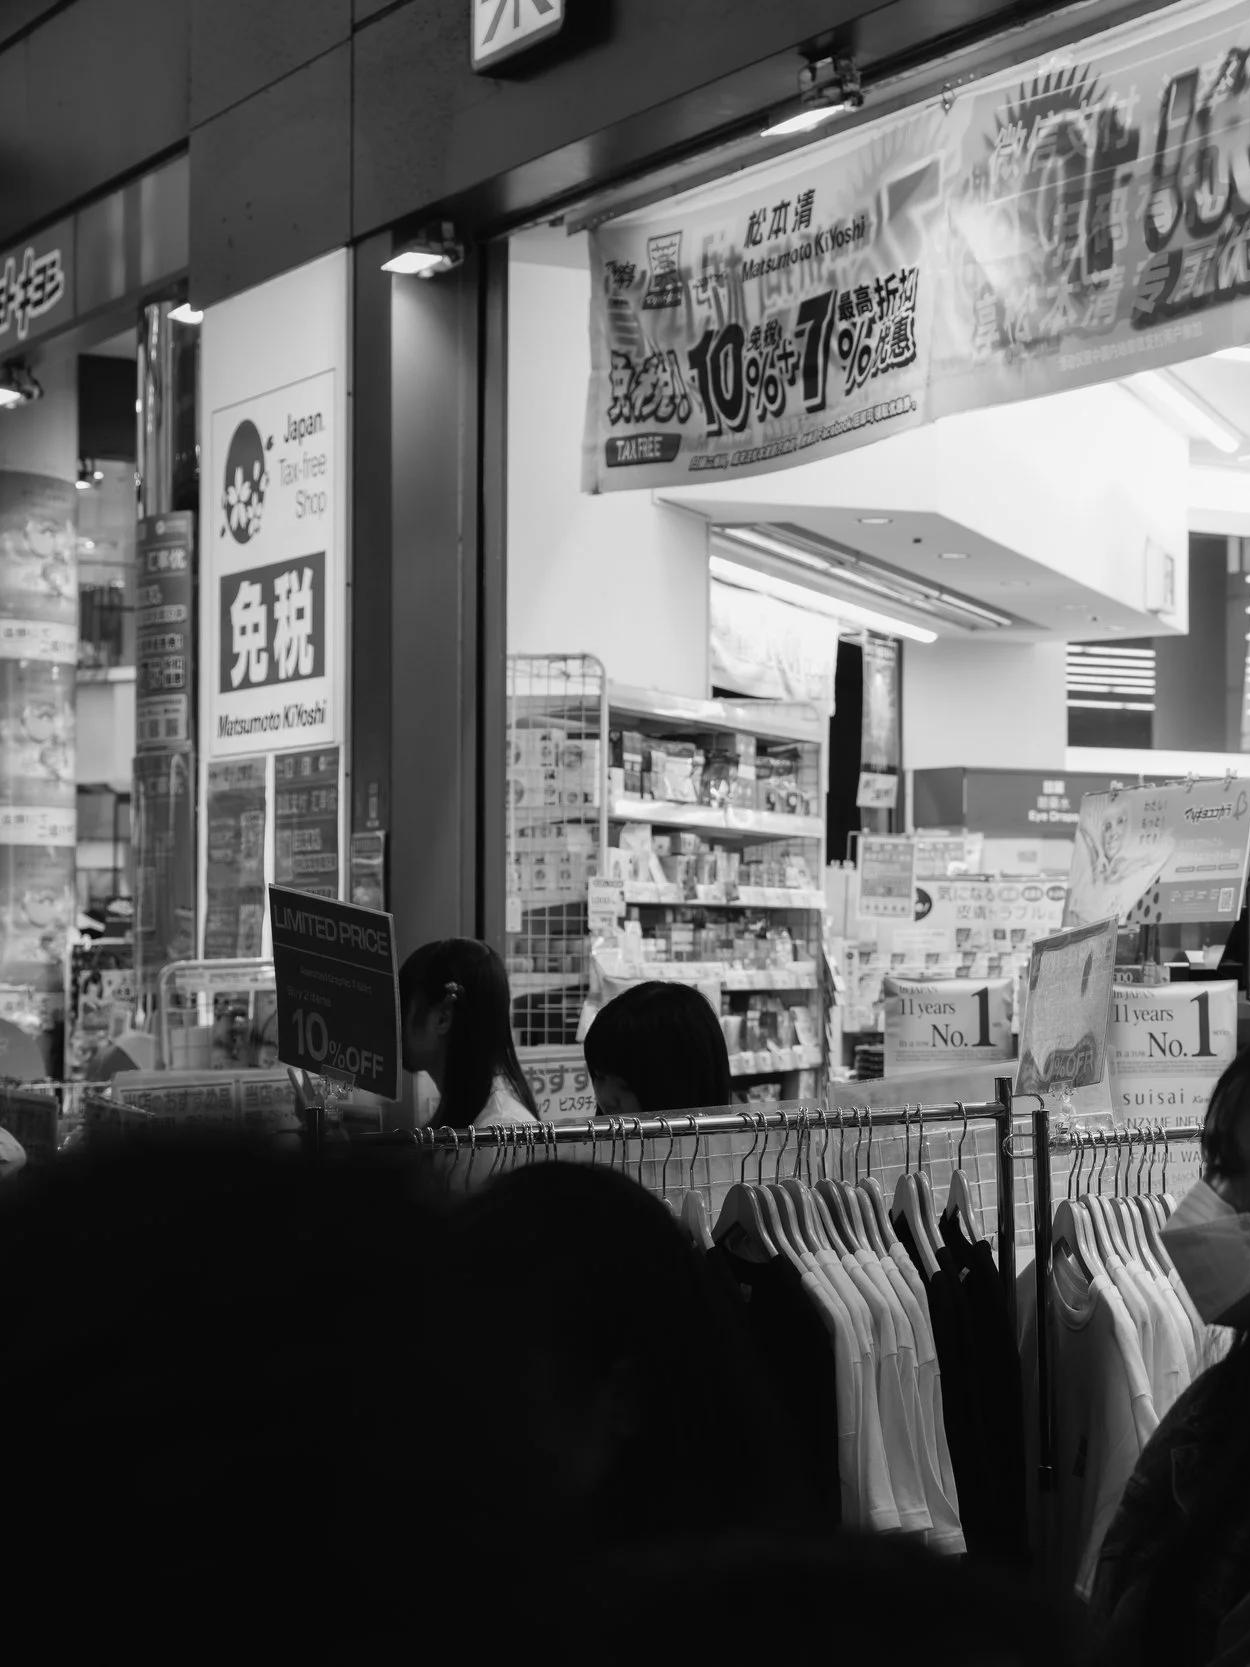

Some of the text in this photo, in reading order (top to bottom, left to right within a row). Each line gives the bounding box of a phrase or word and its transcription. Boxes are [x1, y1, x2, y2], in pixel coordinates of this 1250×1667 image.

[743, 188, 817, 250] 松本清
[741, 240, 813, 284] Matsumoto
[813, 213, 867, 258] KiYoshi
[278, 452, 328, 488] Tax-free
[295, 489, 328, 519] Shop
[229, 566, 316, 688] 免税
[217, 709, 280, 738] Matsumoto
[282, 700, 327, 731] KiYoshi
[273, 904, 389, 957] LIMITED PRICE
[917, 1001, 956, 1019] years
[1133, 1008, 1174, 1026] years
[1123, 1088, 1184, 1106] suisai
